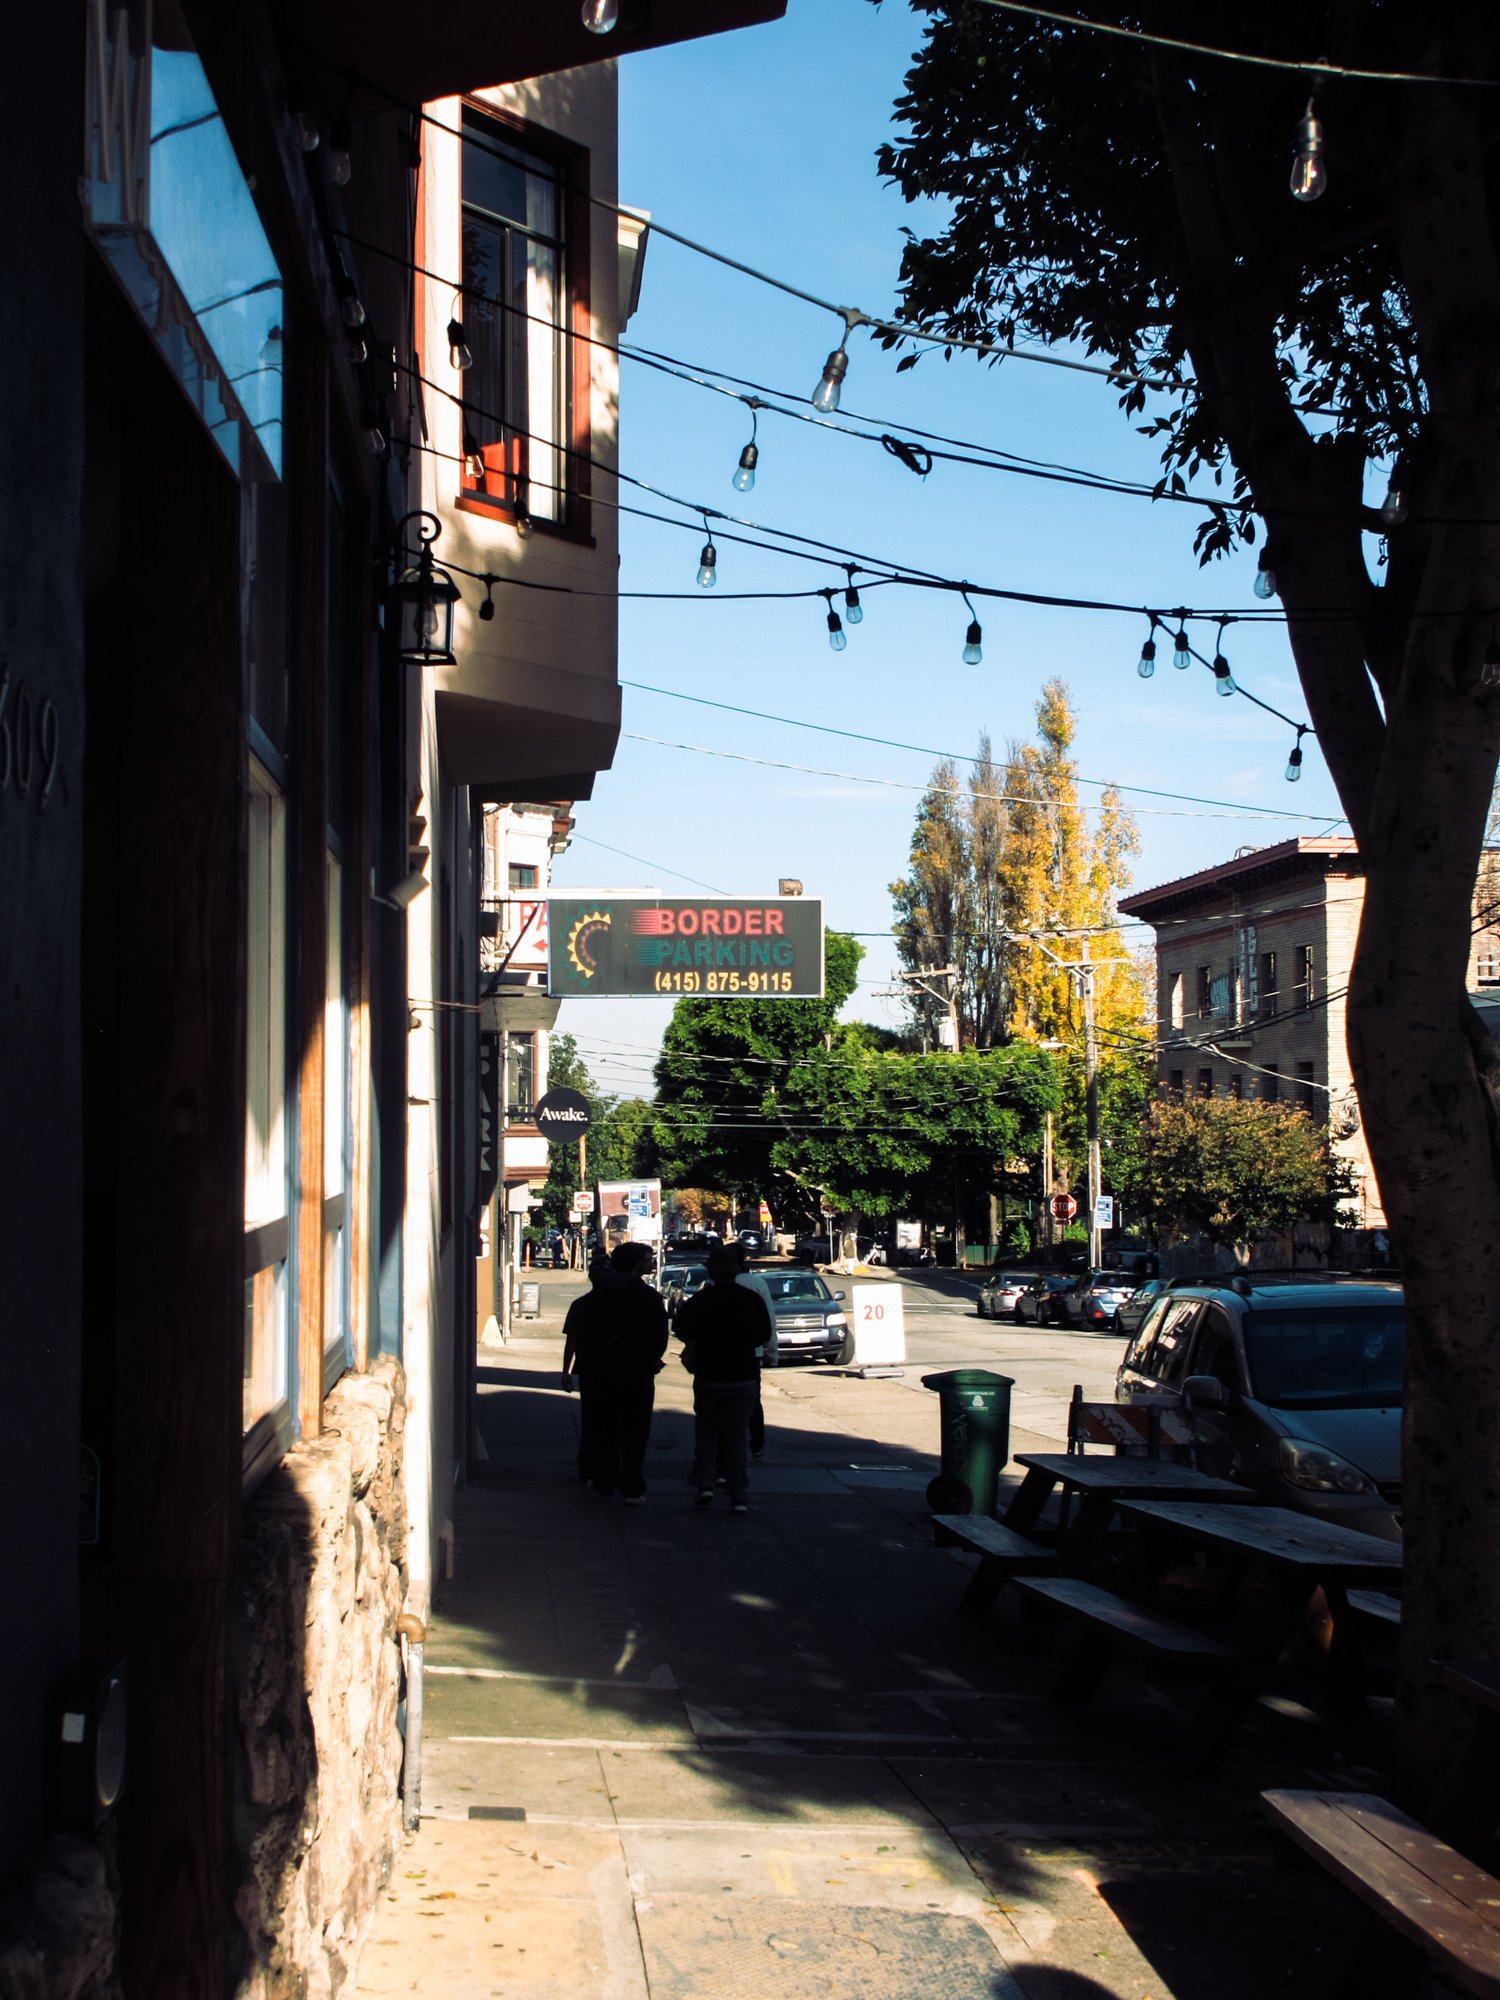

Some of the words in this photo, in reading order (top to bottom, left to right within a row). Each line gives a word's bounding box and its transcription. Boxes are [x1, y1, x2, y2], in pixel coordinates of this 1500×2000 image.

[656, 908, 785, 935] BORDER
[655, 940, 794, 966] PARKING
[655, 972, 701, 991] (415)
[706, 972, 792, 992] 875-9115
[539, 1106, 588, 1121] Awake.
[1052, 1202, 1075, 1212] STOP
